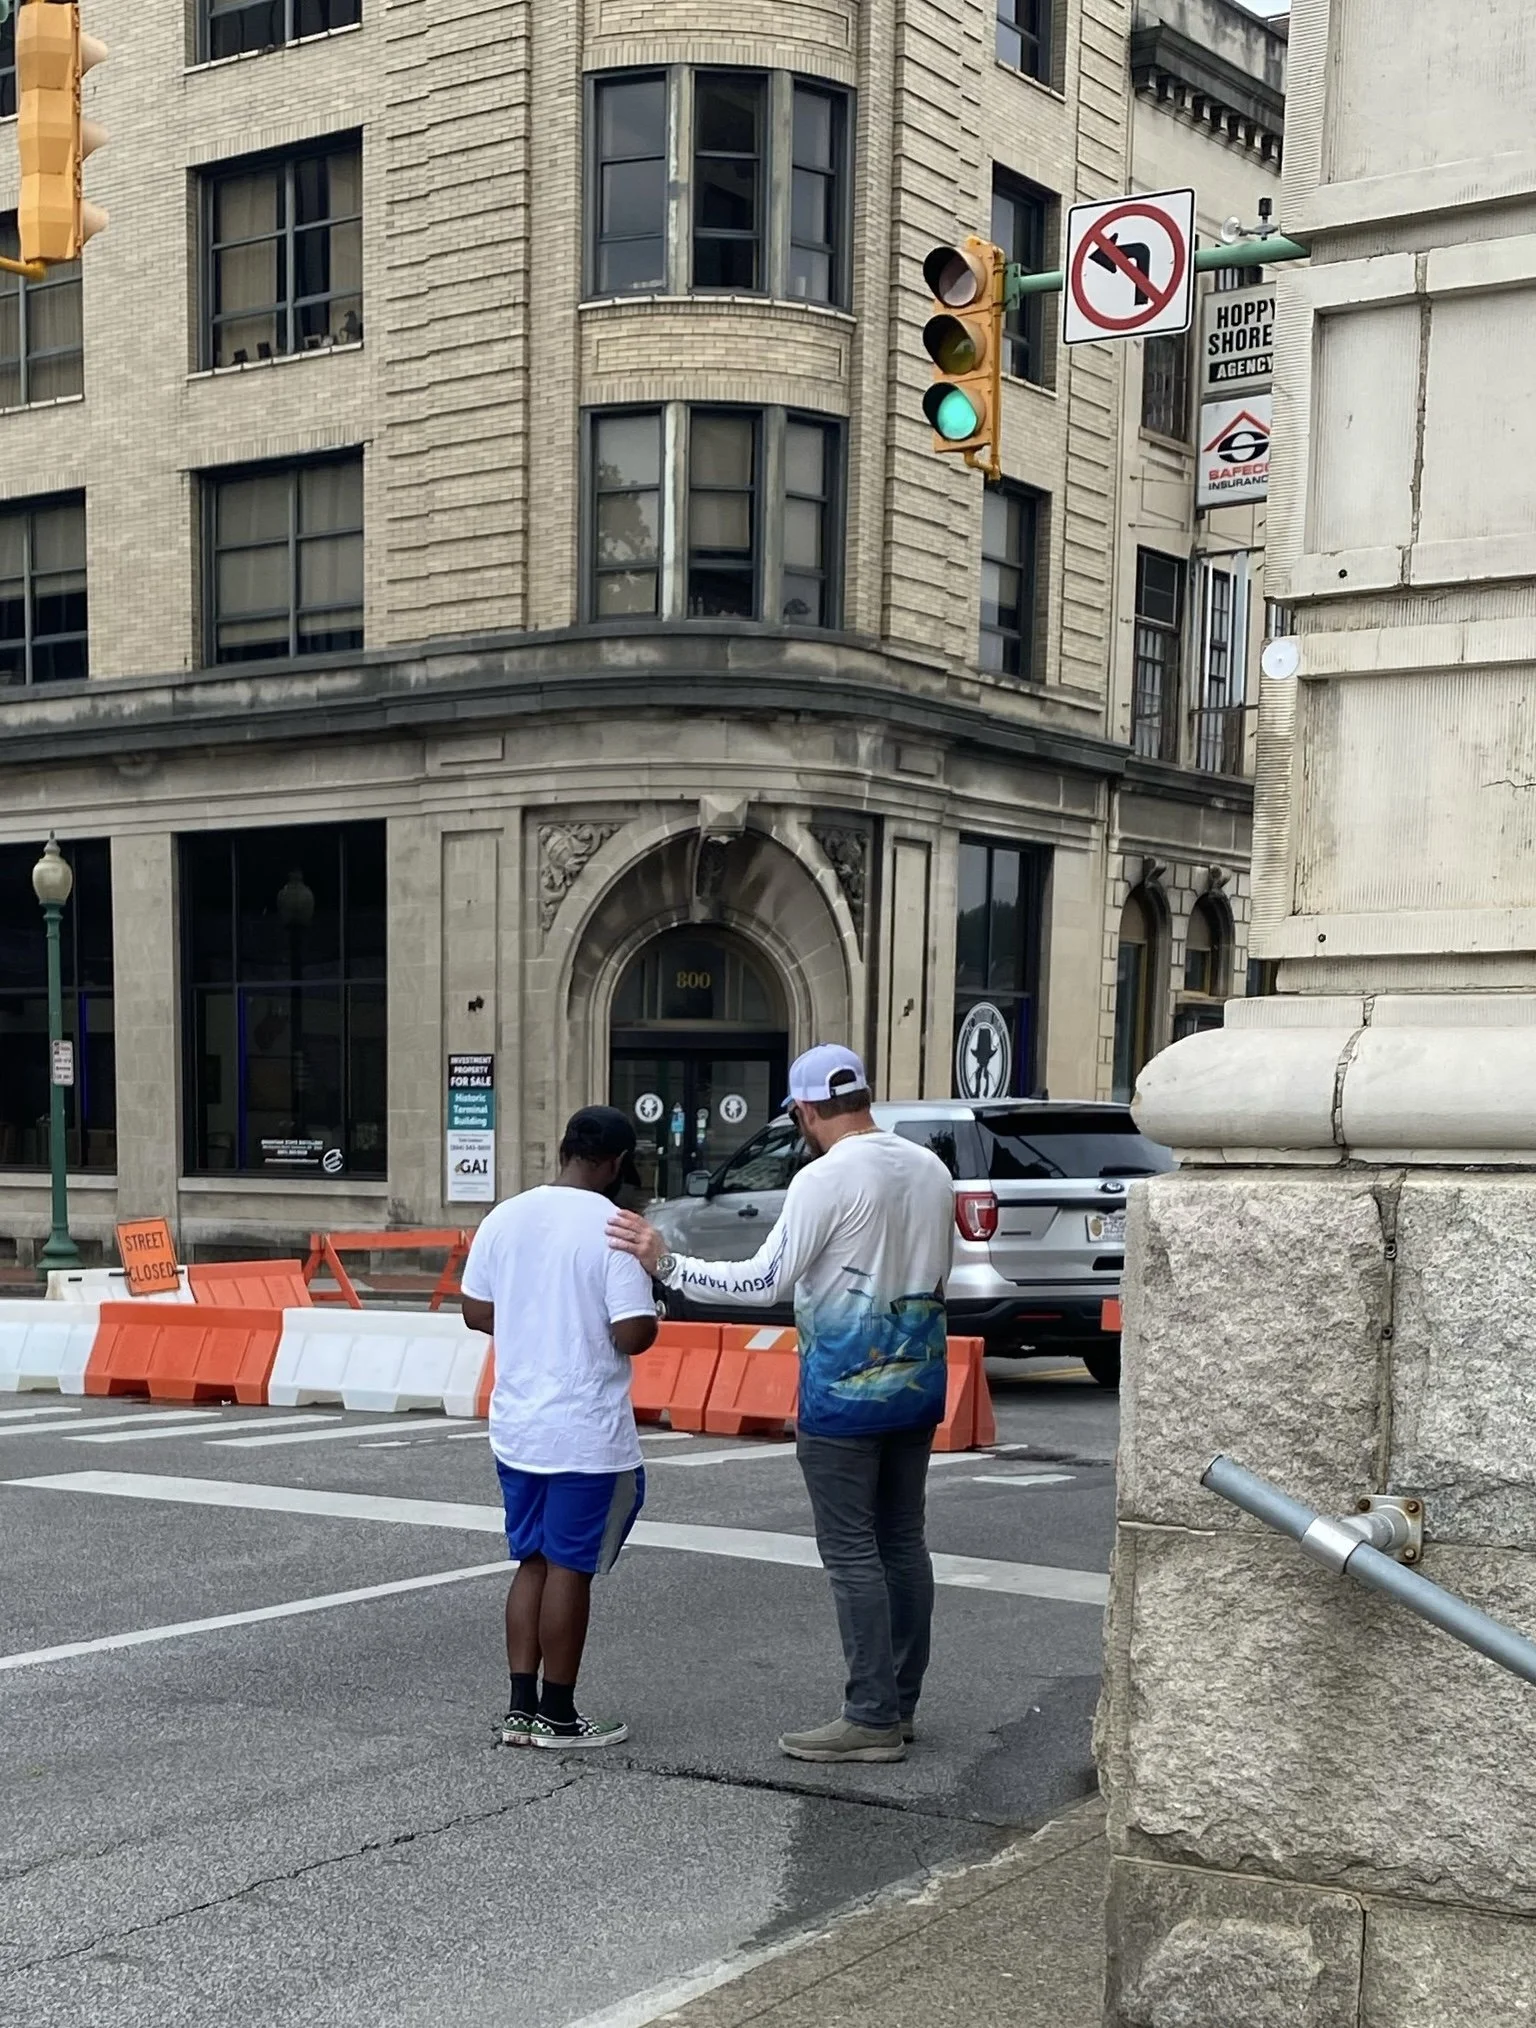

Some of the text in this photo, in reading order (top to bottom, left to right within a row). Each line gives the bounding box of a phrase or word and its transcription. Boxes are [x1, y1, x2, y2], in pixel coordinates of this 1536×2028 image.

[1208, 324, 1272, 356] SHORE
[1217, 356, 1273, 379] AGENCY
[676, 971, 711, 989] 800
[450, 1056, 492, 1064] INVESTMENT
[454, 1065, 489, 1074] PROPERTY
[450, 1076, 492, 1087] FOR SALE
[455, 1093, 487, 1103] Historic
[453, 1104, 489, 1114] Terminal
[454, 1116, 488, 1128] Building
[460, 1158, 489, 1174] GAI
[124, 1232, 165, 1252] STREET
[129, 1262, 174, 1283] CLOSED
[733, 1277, 765, 1293] GUY
